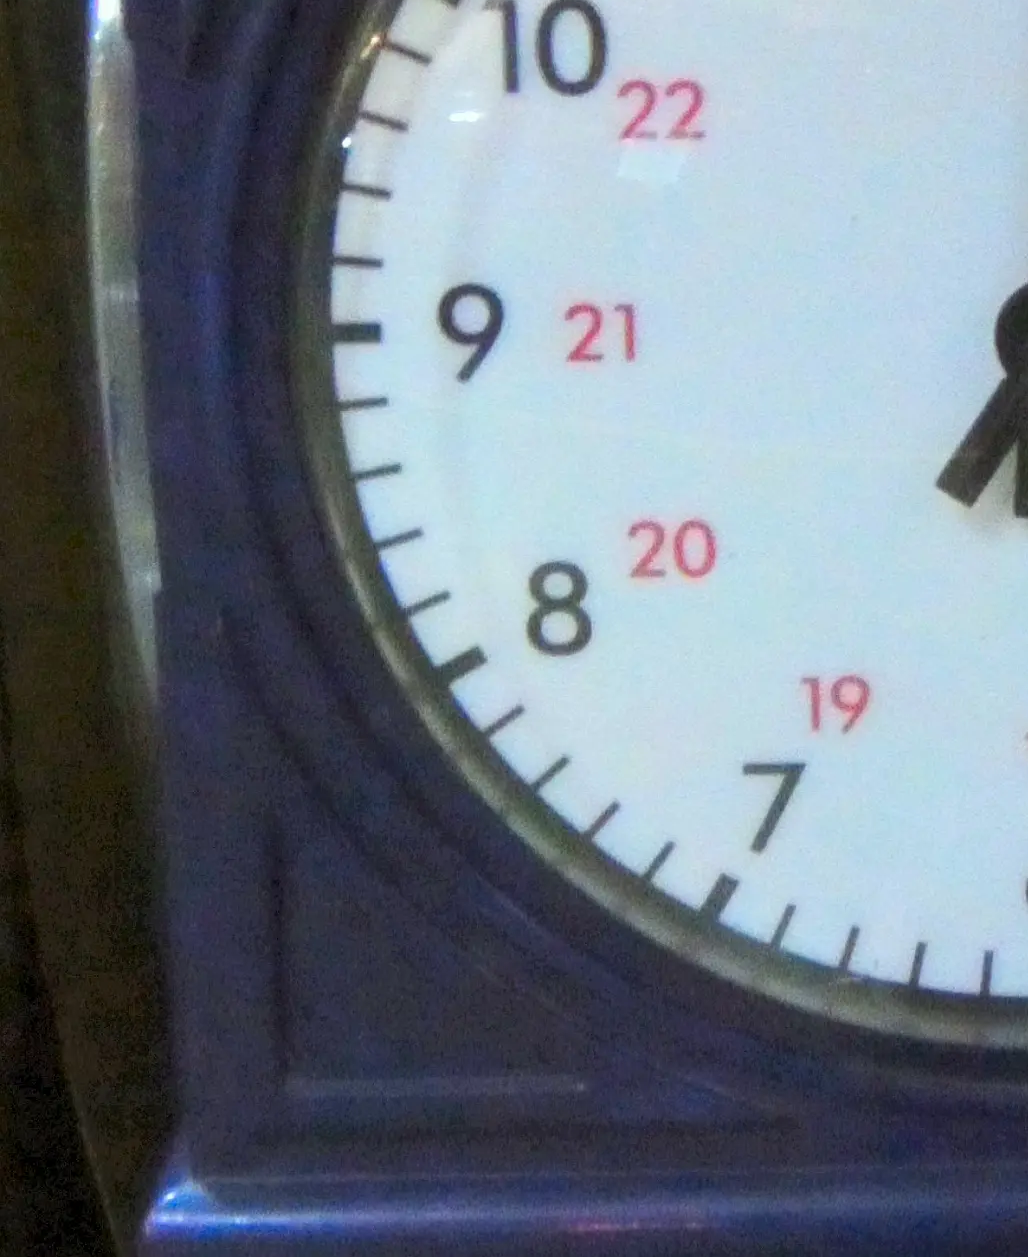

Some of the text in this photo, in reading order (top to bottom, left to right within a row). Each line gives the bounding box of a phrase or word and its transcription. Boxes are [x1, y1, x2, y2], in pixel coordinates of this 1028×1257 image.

[618, 79, 705, 139] 22
[438, 283, 505, 381] 9
[564, 302, 636, 362] 21
[628, 519, 717, 579] 20
[527, 561, 592, 656] 8
[803, 674, 870, 732] 19
[742, 761, 807, 853] 7
